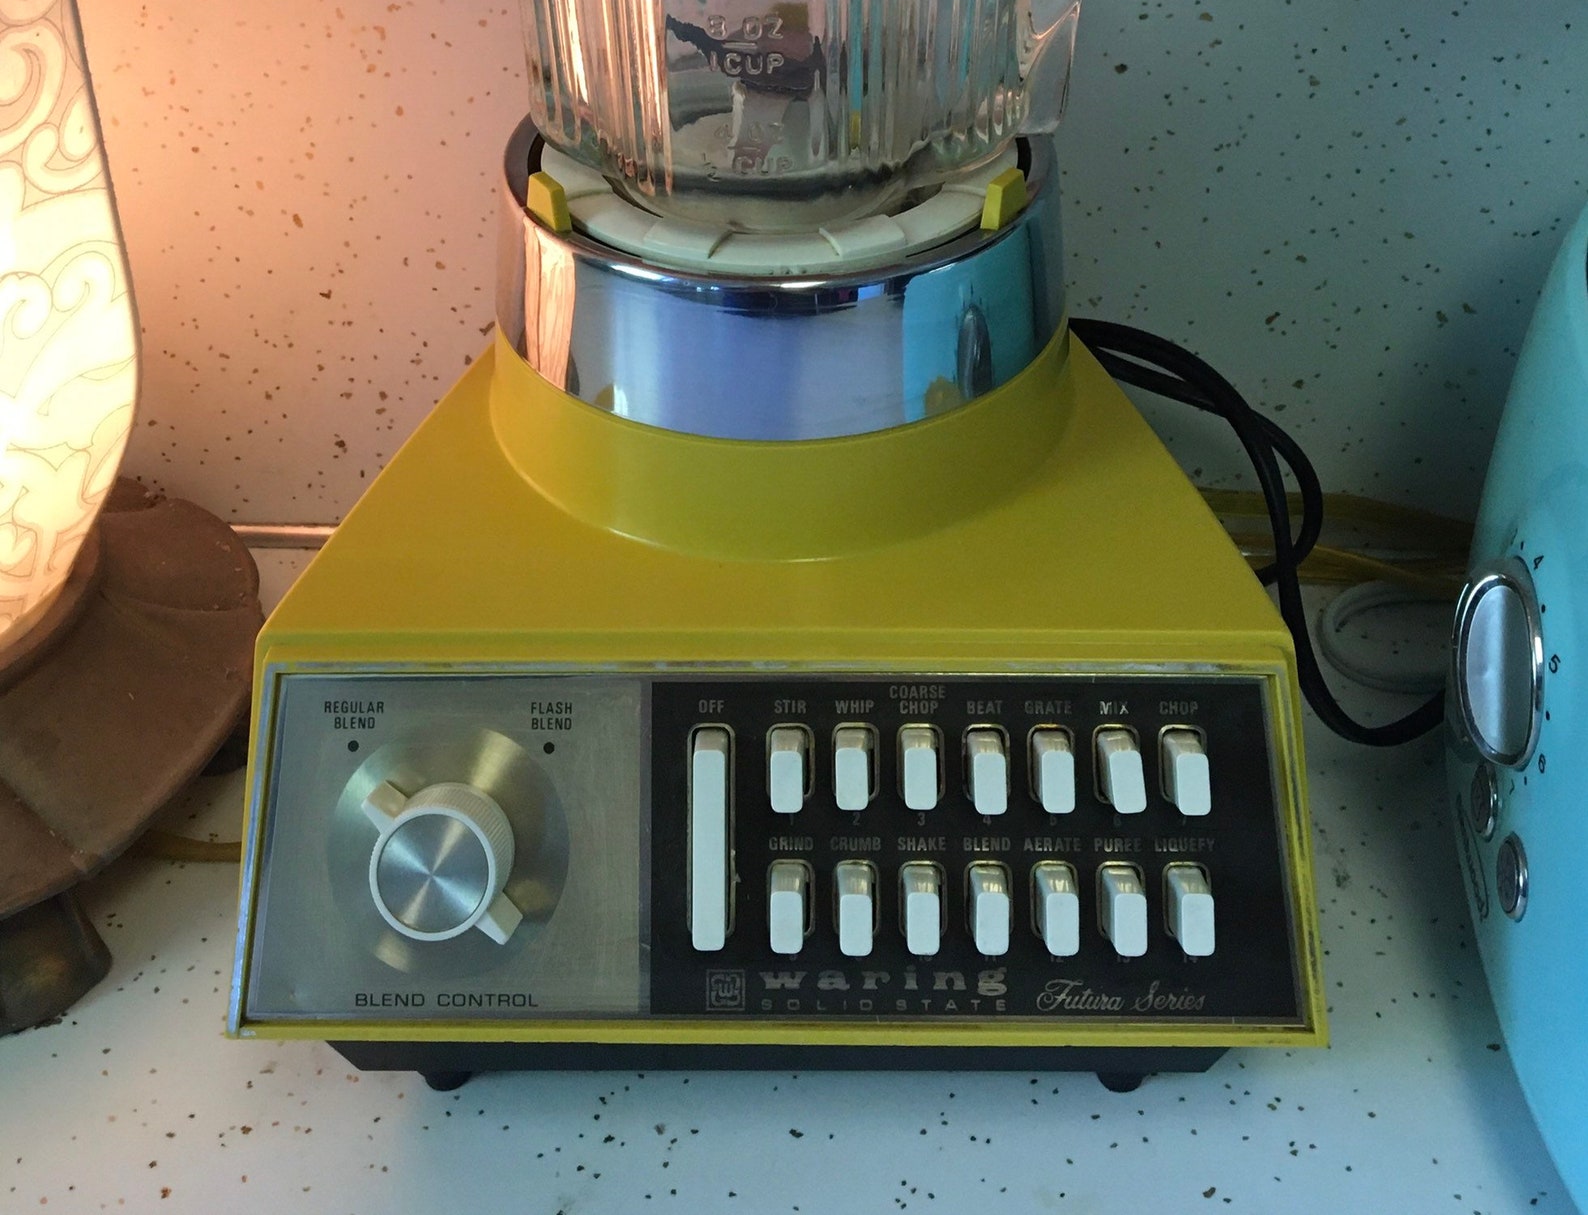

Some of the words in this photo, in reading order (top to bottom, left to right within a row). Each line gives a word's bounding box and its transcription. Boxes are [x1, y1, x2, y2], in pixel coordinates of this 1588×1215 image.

[742, 16, 784, 41] OZ
[723, 52, 785, 76] CUP
[1549, 654, 1561, 674] 5
[889, 685, 946, 699] COARSE
[324, 700, 385, 714] REGULAR
[530, 702, 573, 715] FLASH
[698, 700, 725, 714] OFF
[774, 700, 807, 714] STIR
[835, 700, 875, 714] WHIP
[900, 701, 939, 715] CHOP
[966, 701, 1003, 715] BEAT
[1024, 701, 1072, 715] GRATE
[1099, 701, 1129, 715] MIX
[1159, 701, 1199, 715] CHOP
[334, 716, 376, 730] BLEND
[531, 718, 573, 731] BLEND
[1537, 753, 1547, 774] 6
[917, 812, 926, 826] 3
[768, 837, 814, 851] GRIND
[830, 837, 882, 851] CRUMB
[897, 837, 947, 851] SHAKE
[963, 837, 1011, 852] BLEND
[1023, 837, 1082, 852] AERATE
[1094, 837, 1142, 852] PUREE
[1154, 837, 1216, 853] LIQUEFY
[758, 964, 1008, 996] waring
[355, 993, 425, 1008] BLEND
[437, 993, 539, 1008] CONTROL
[1036, 979, 1125, 1011] Futura
[1132, 980, 1207, 1012] Series
[761, 999, 874, 1011] SOLID
[896, 999, 1007, 1011] STATE
